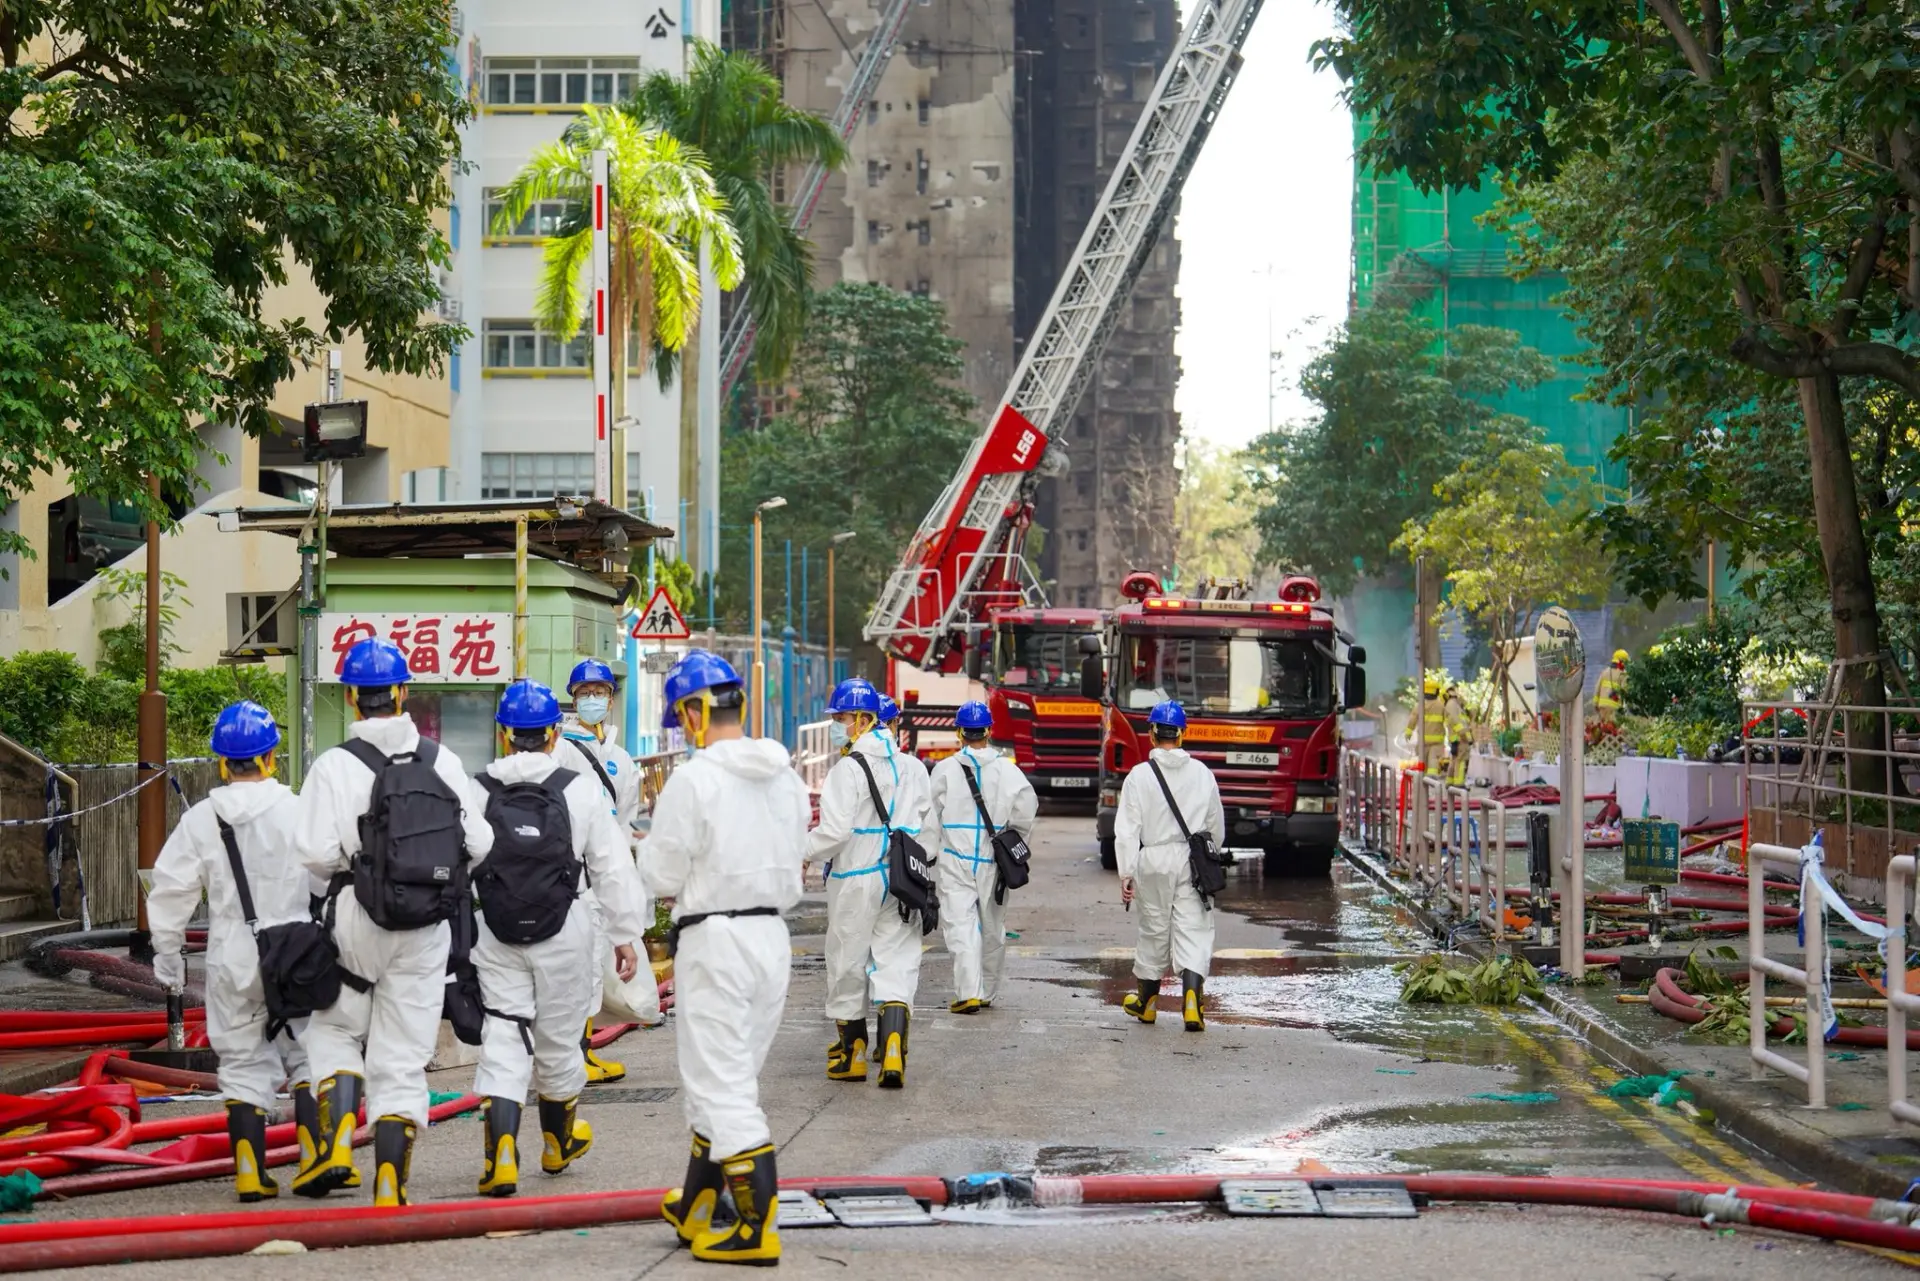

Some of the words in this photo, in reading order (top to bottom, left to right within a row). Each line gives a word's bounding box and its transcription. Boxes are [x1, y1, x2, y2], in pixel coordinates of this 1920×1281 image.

[645, 8, 676, 38] 公
[1189, 727, 1208, 738] FIRE
[1211, 728, 1255, 739] SERVICES
[1236, 753, 1243, 763] F
[1248, 754, 1270, 764] 466
